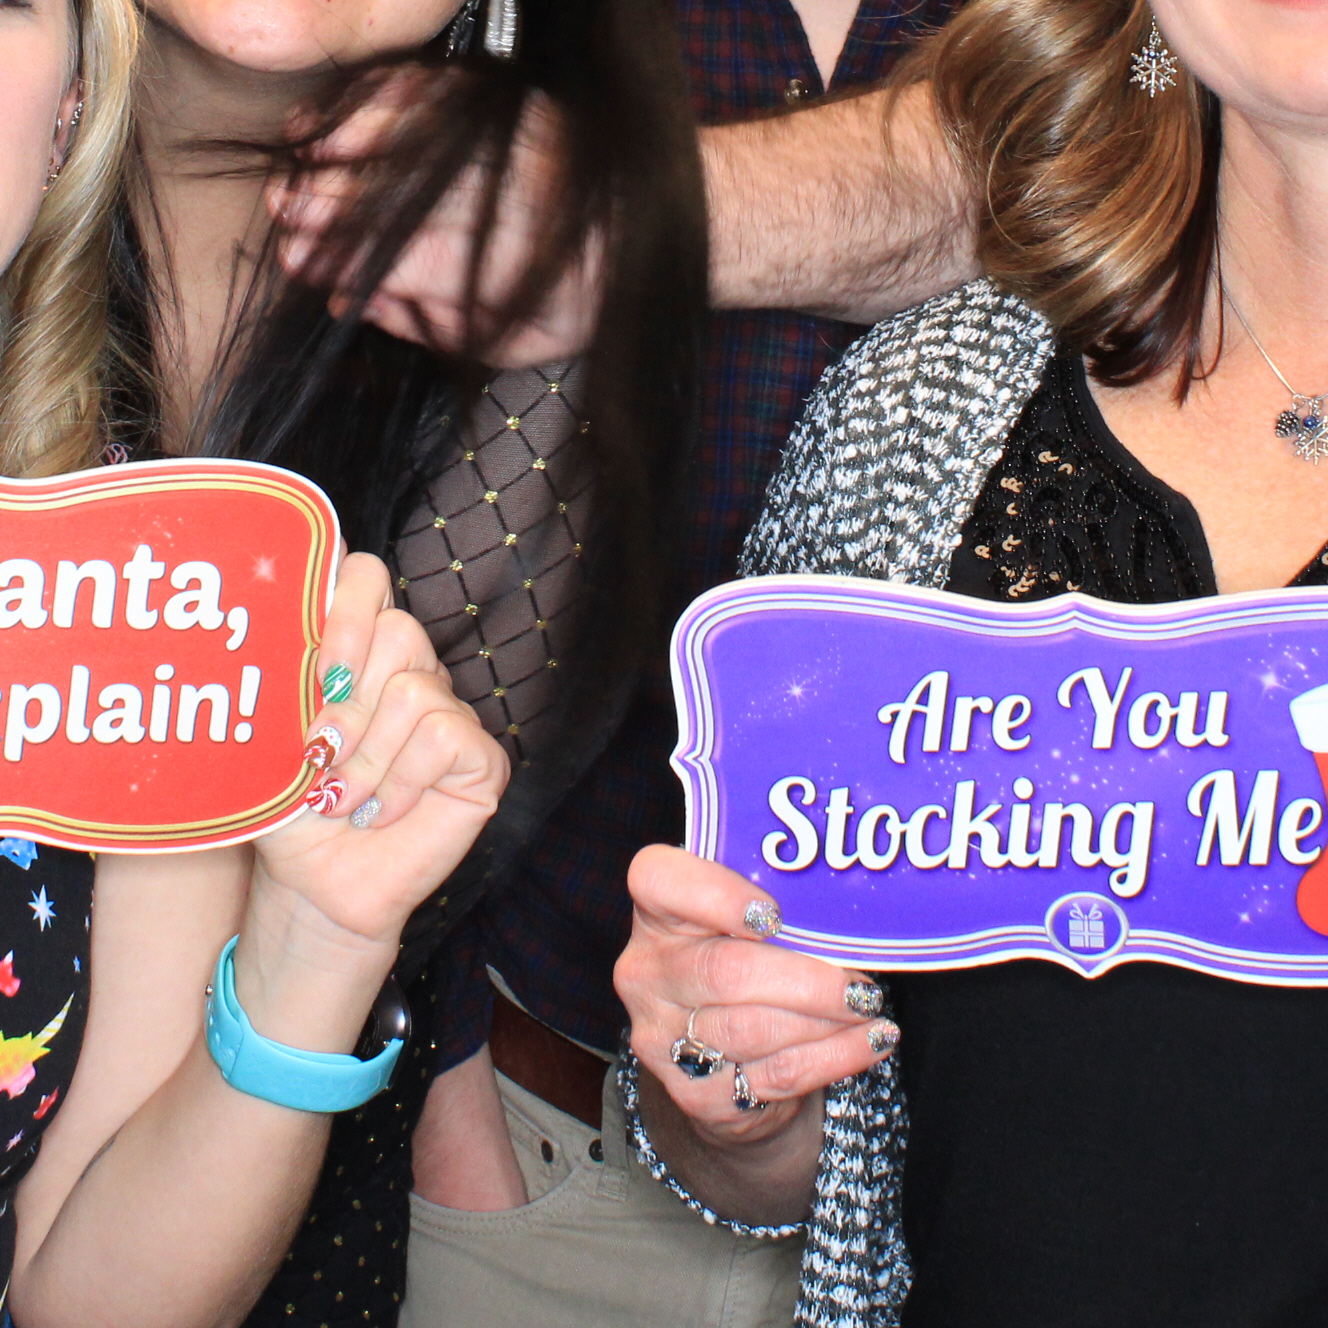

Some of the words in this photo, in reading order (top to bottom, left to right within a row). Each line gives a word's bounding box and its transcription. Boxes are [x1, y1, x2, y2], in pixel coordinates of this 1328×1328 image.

[877, 670, 1032, 765] Are
[1057, 666, 1230, 751] You
[760, 776, 1156, 899] Stocking
